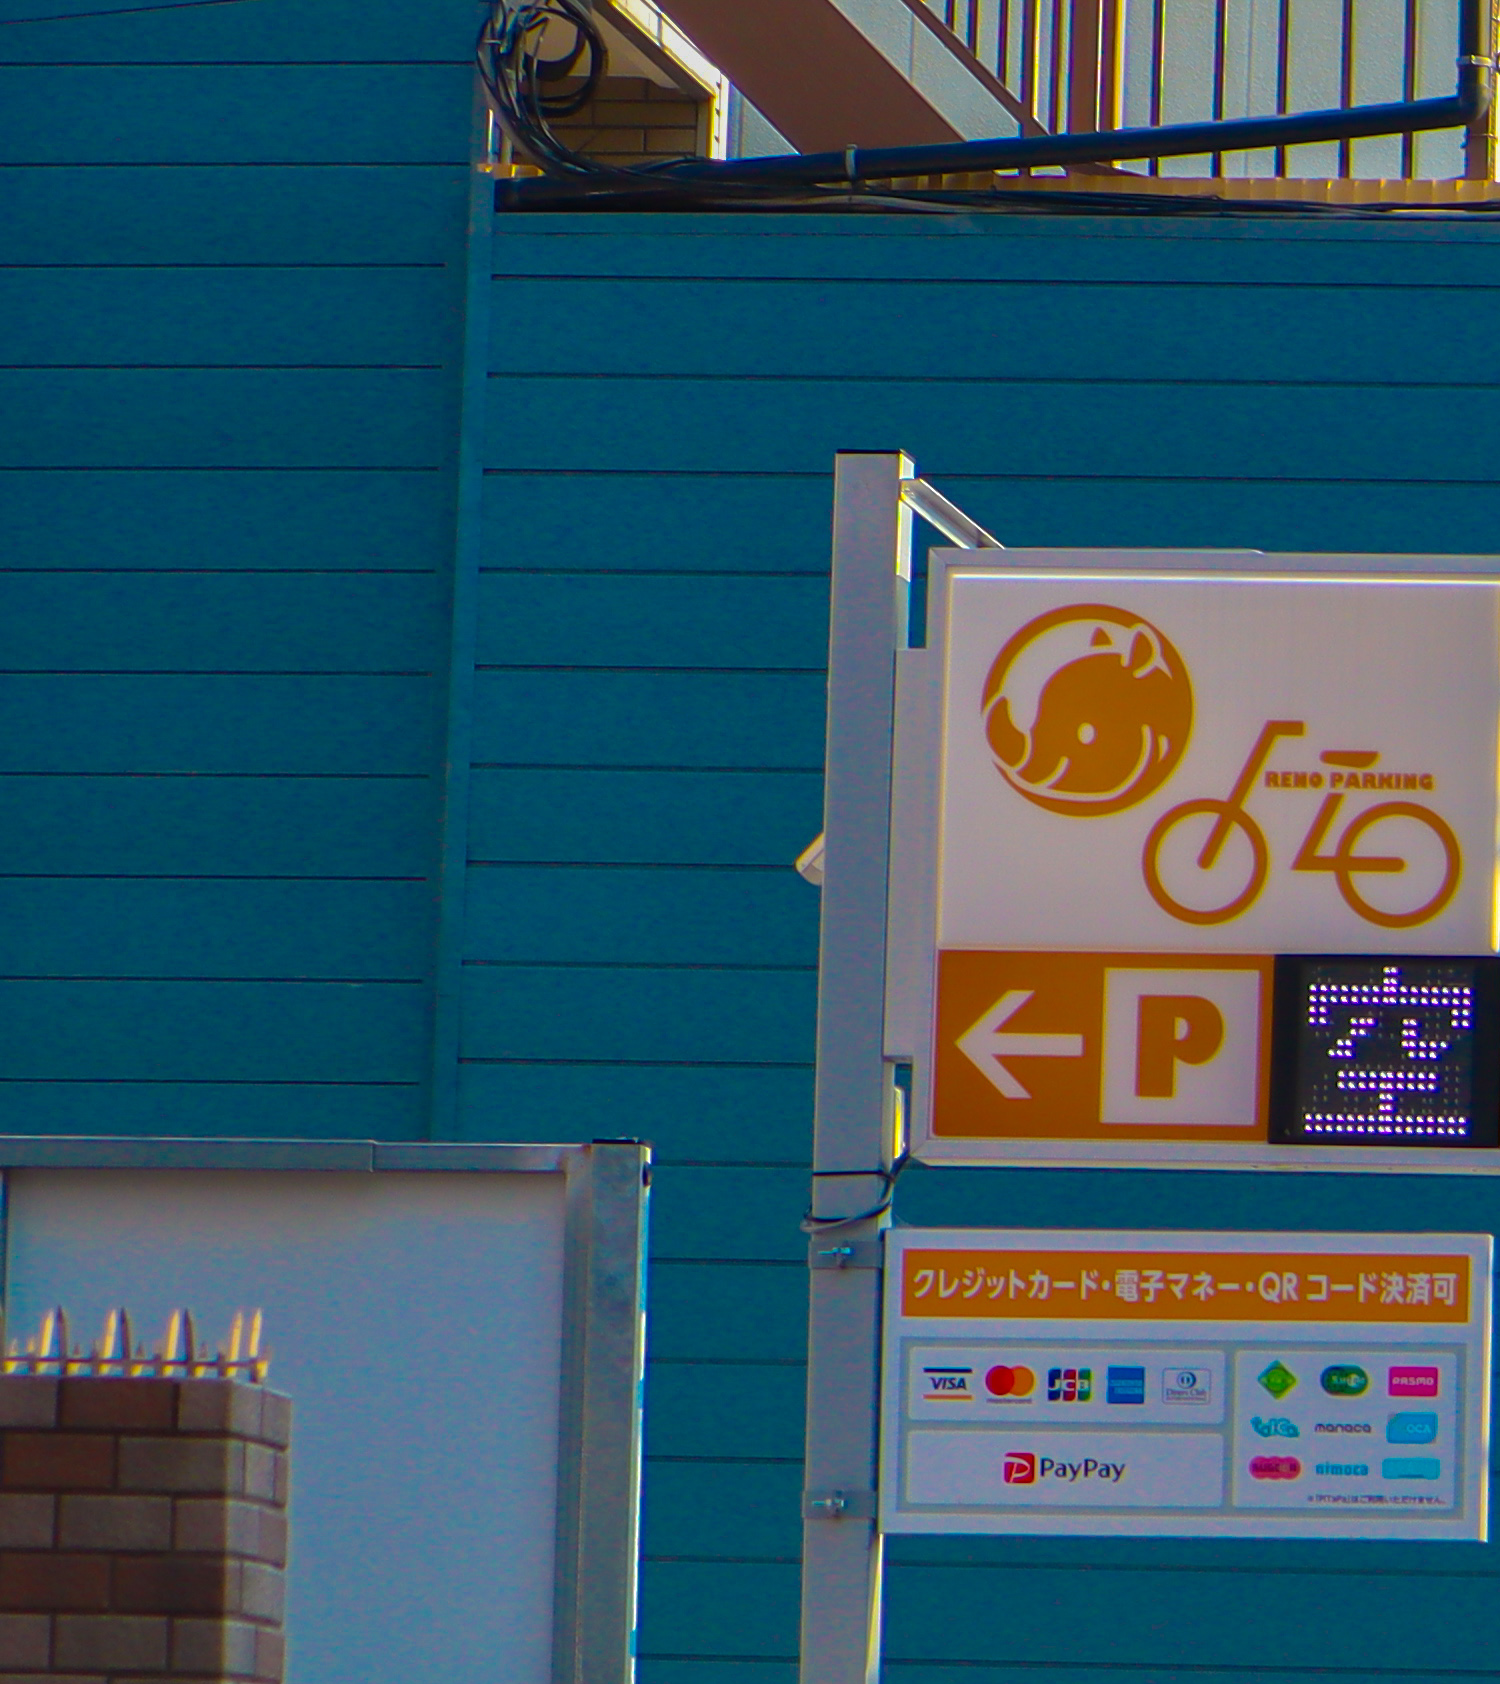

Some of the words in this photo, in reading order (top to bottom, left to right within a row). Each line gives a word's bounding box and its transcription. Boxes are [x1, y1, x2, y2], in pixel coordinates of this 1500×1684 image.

[1265, 770, 1322, 791] RENO
[1329, 770, 1435, 792] PARKING
[1135, 993, 1225, 1099] P
[1303, 965, 1474, 1135] 空
[930, 1376, 968, 1391] VISA
[1048, 1378, 1091, 1392] JCB
[1391, 1376, 1434, 1387] PASMO
[1314, 1422, 1372, 1434] manaca
[1040, 1457, 1126, 1482] PayPay
[1315, 1460, 1369, 1476] nimoca
